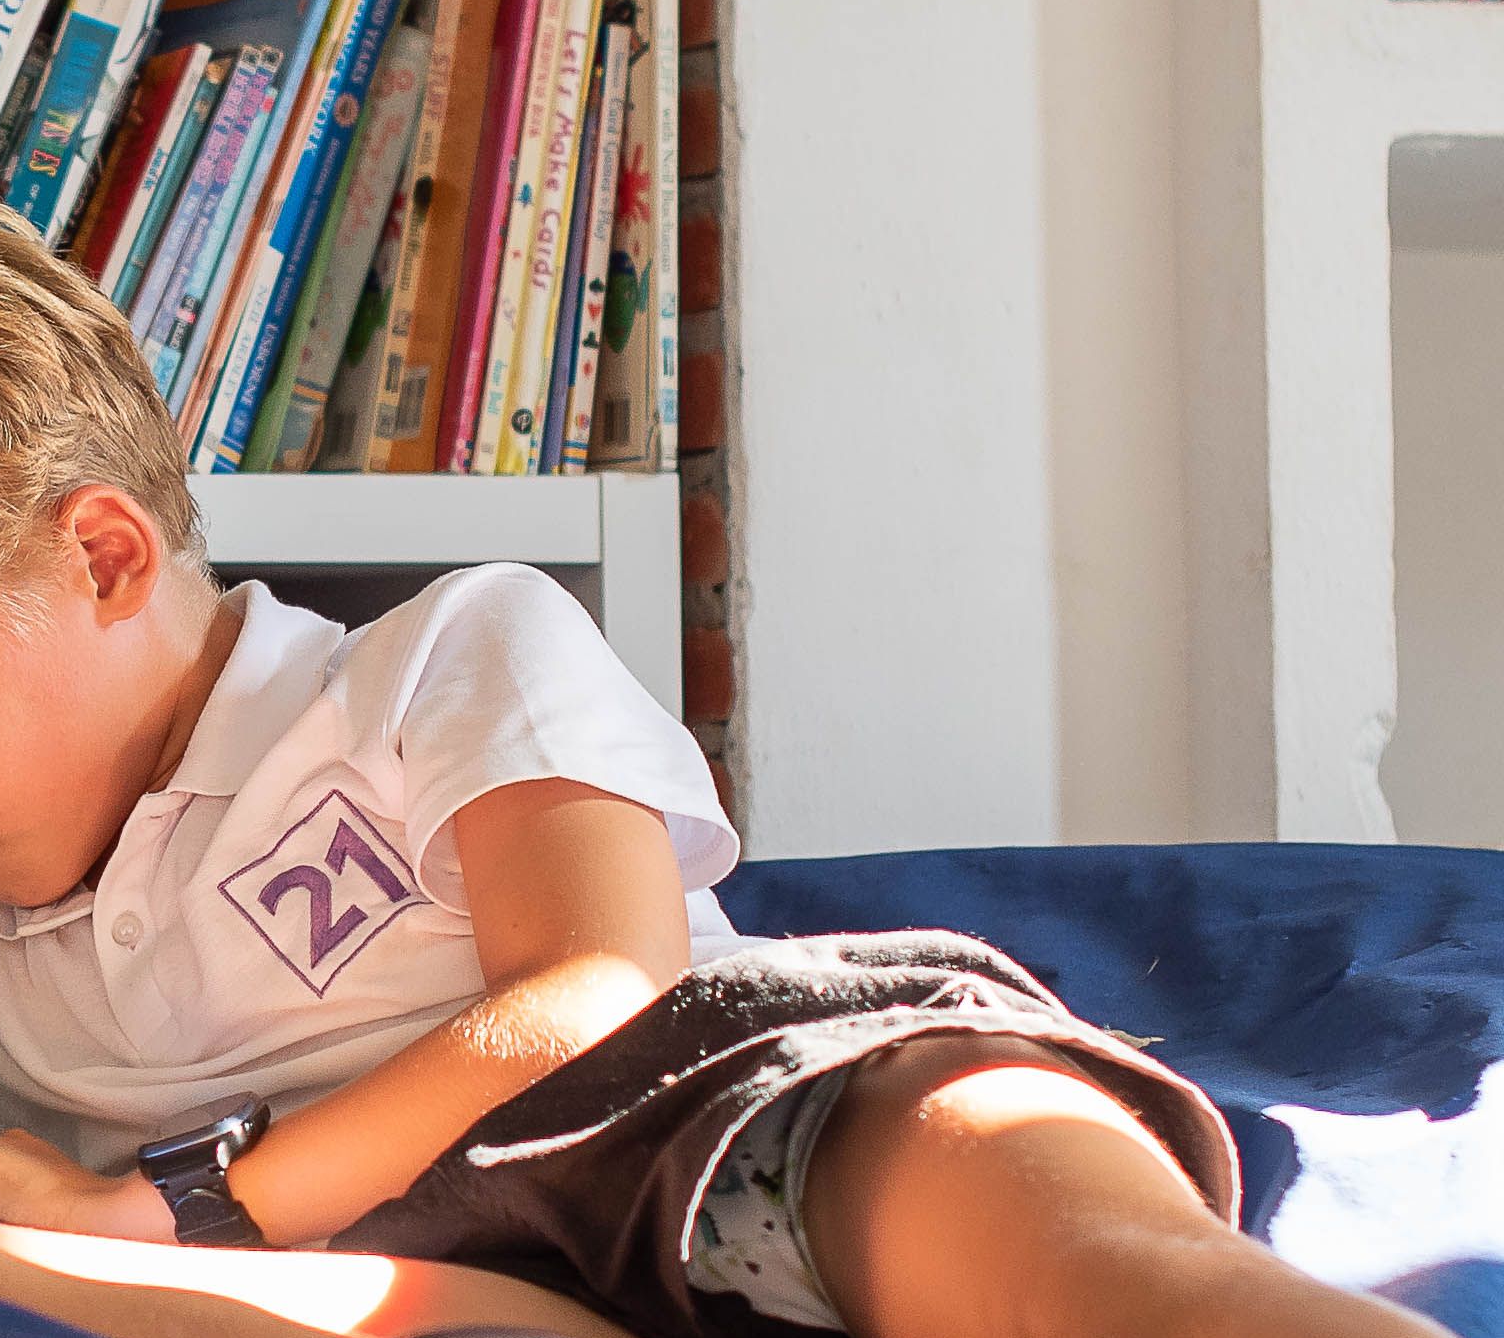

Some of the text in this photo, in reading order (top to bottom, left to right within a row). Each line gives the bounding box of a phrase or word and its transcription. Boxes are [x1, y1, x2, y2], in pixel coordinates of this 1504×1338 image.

[553, 29, 589, 100] Let's
[541, 112, 577, 192] Make
[660, 107, 674, 142] with
[660, 149, 674, 180] Neil
[526, 206, 563, 292] Cards
[257, 817, 411, 970] 21
